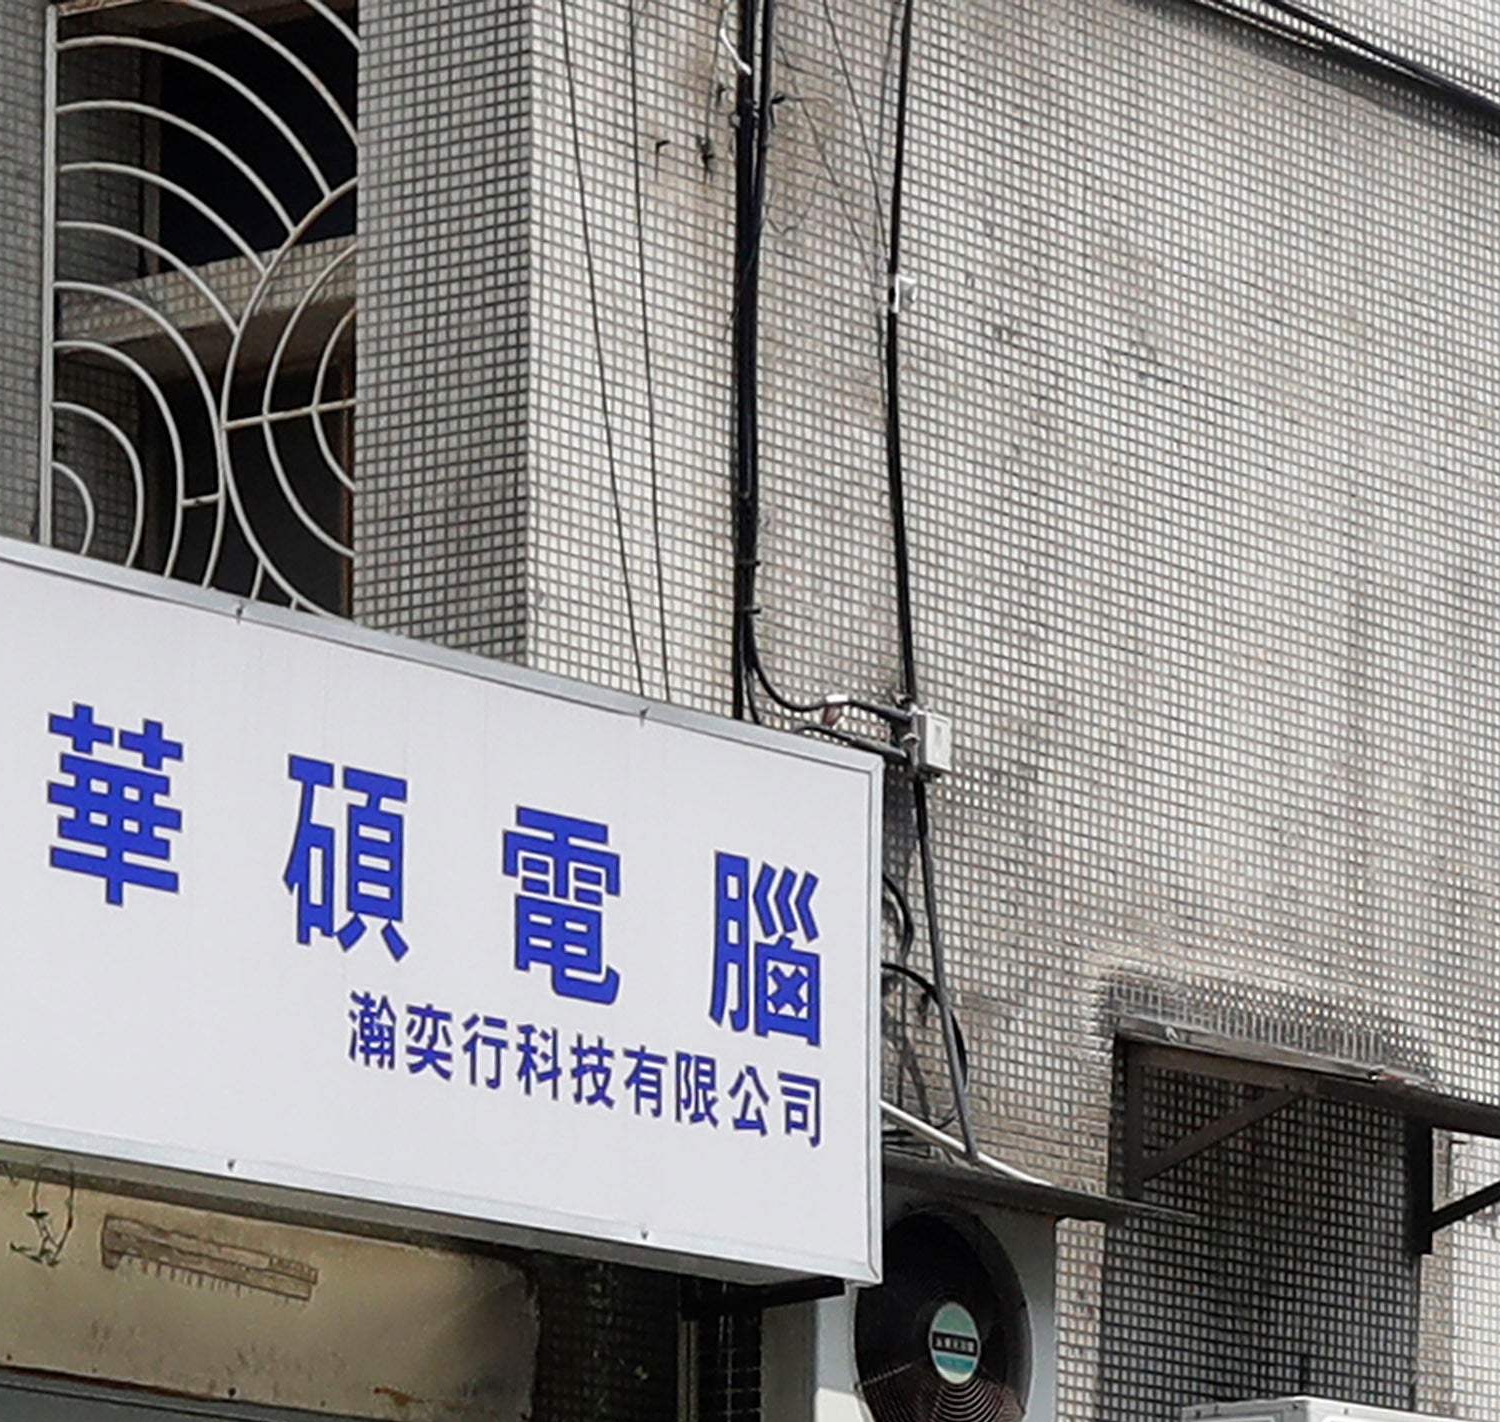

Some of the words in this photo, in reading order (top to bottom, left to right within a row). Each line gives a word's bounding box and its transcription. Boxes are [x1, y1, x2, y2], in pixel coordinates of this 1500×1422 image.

[47, 702, 823, 1048] 華碩電腦
[347, 989, 822, 1149] 瀚奕行科技有限公司
